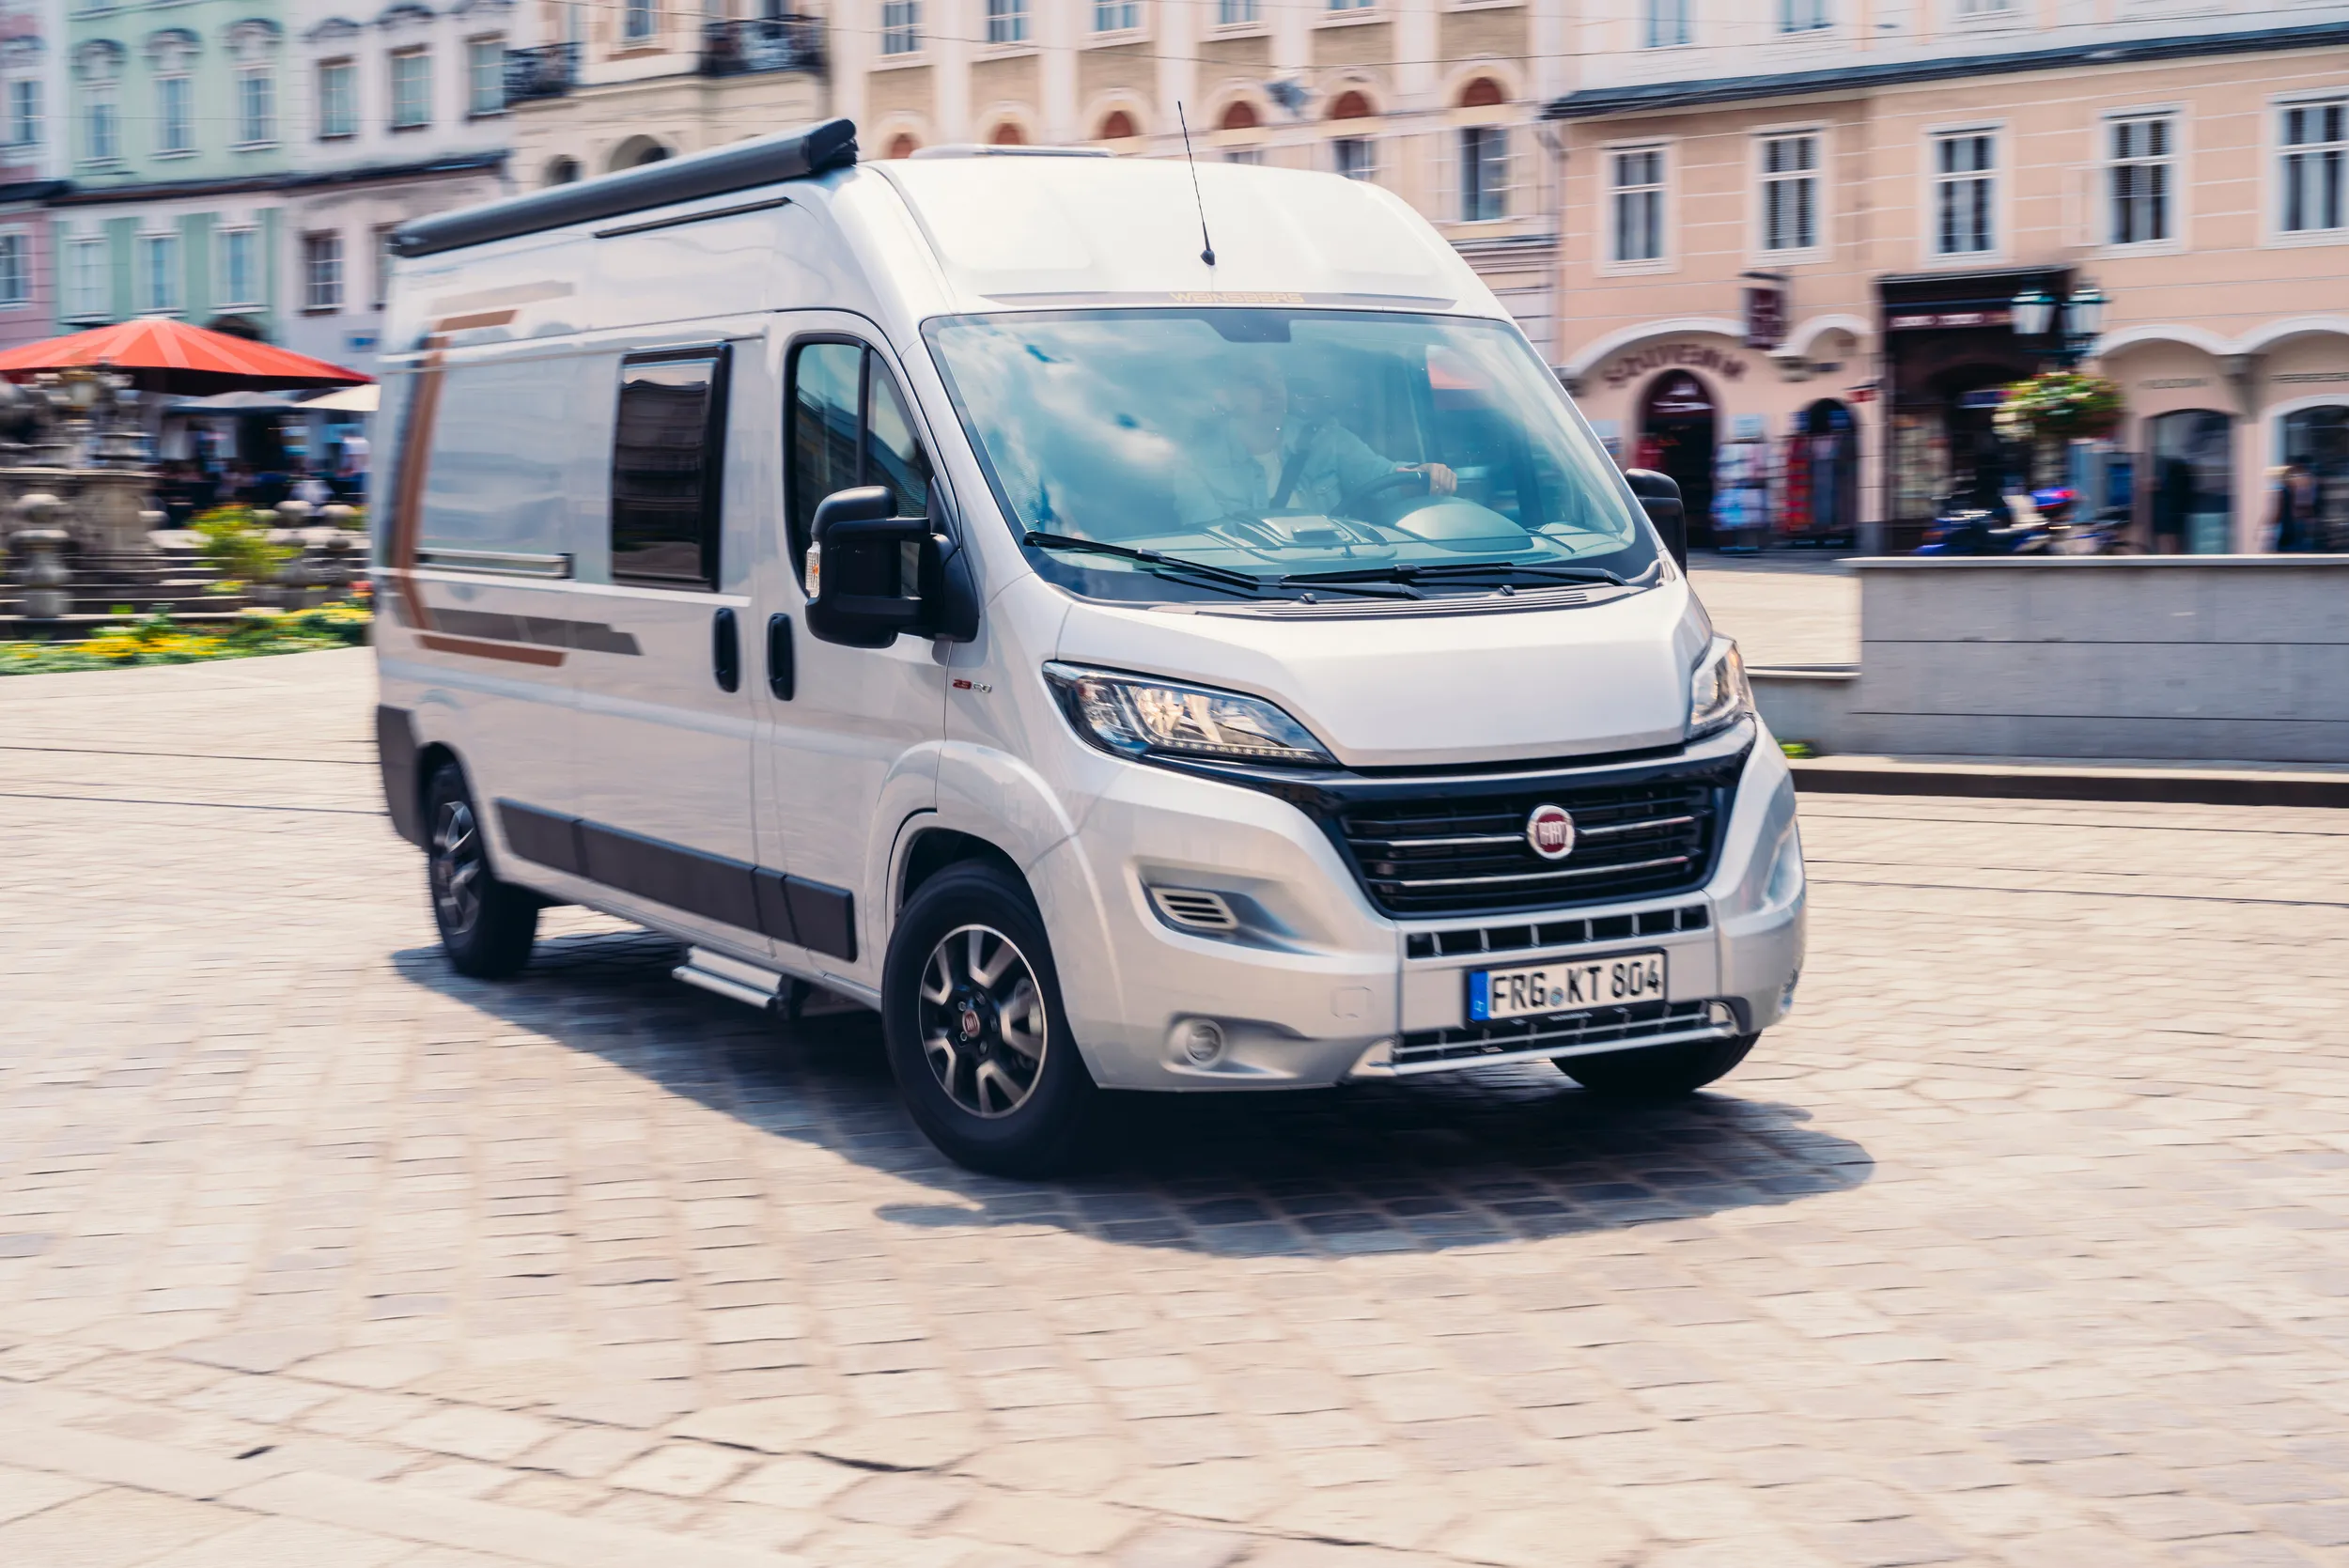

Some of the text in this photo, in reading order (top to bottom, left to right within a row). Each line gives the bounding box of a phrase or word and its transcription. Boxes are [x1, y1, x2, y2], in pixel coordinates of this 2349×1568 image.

[1492, 959, 1662, 1012] FRG KT 804
